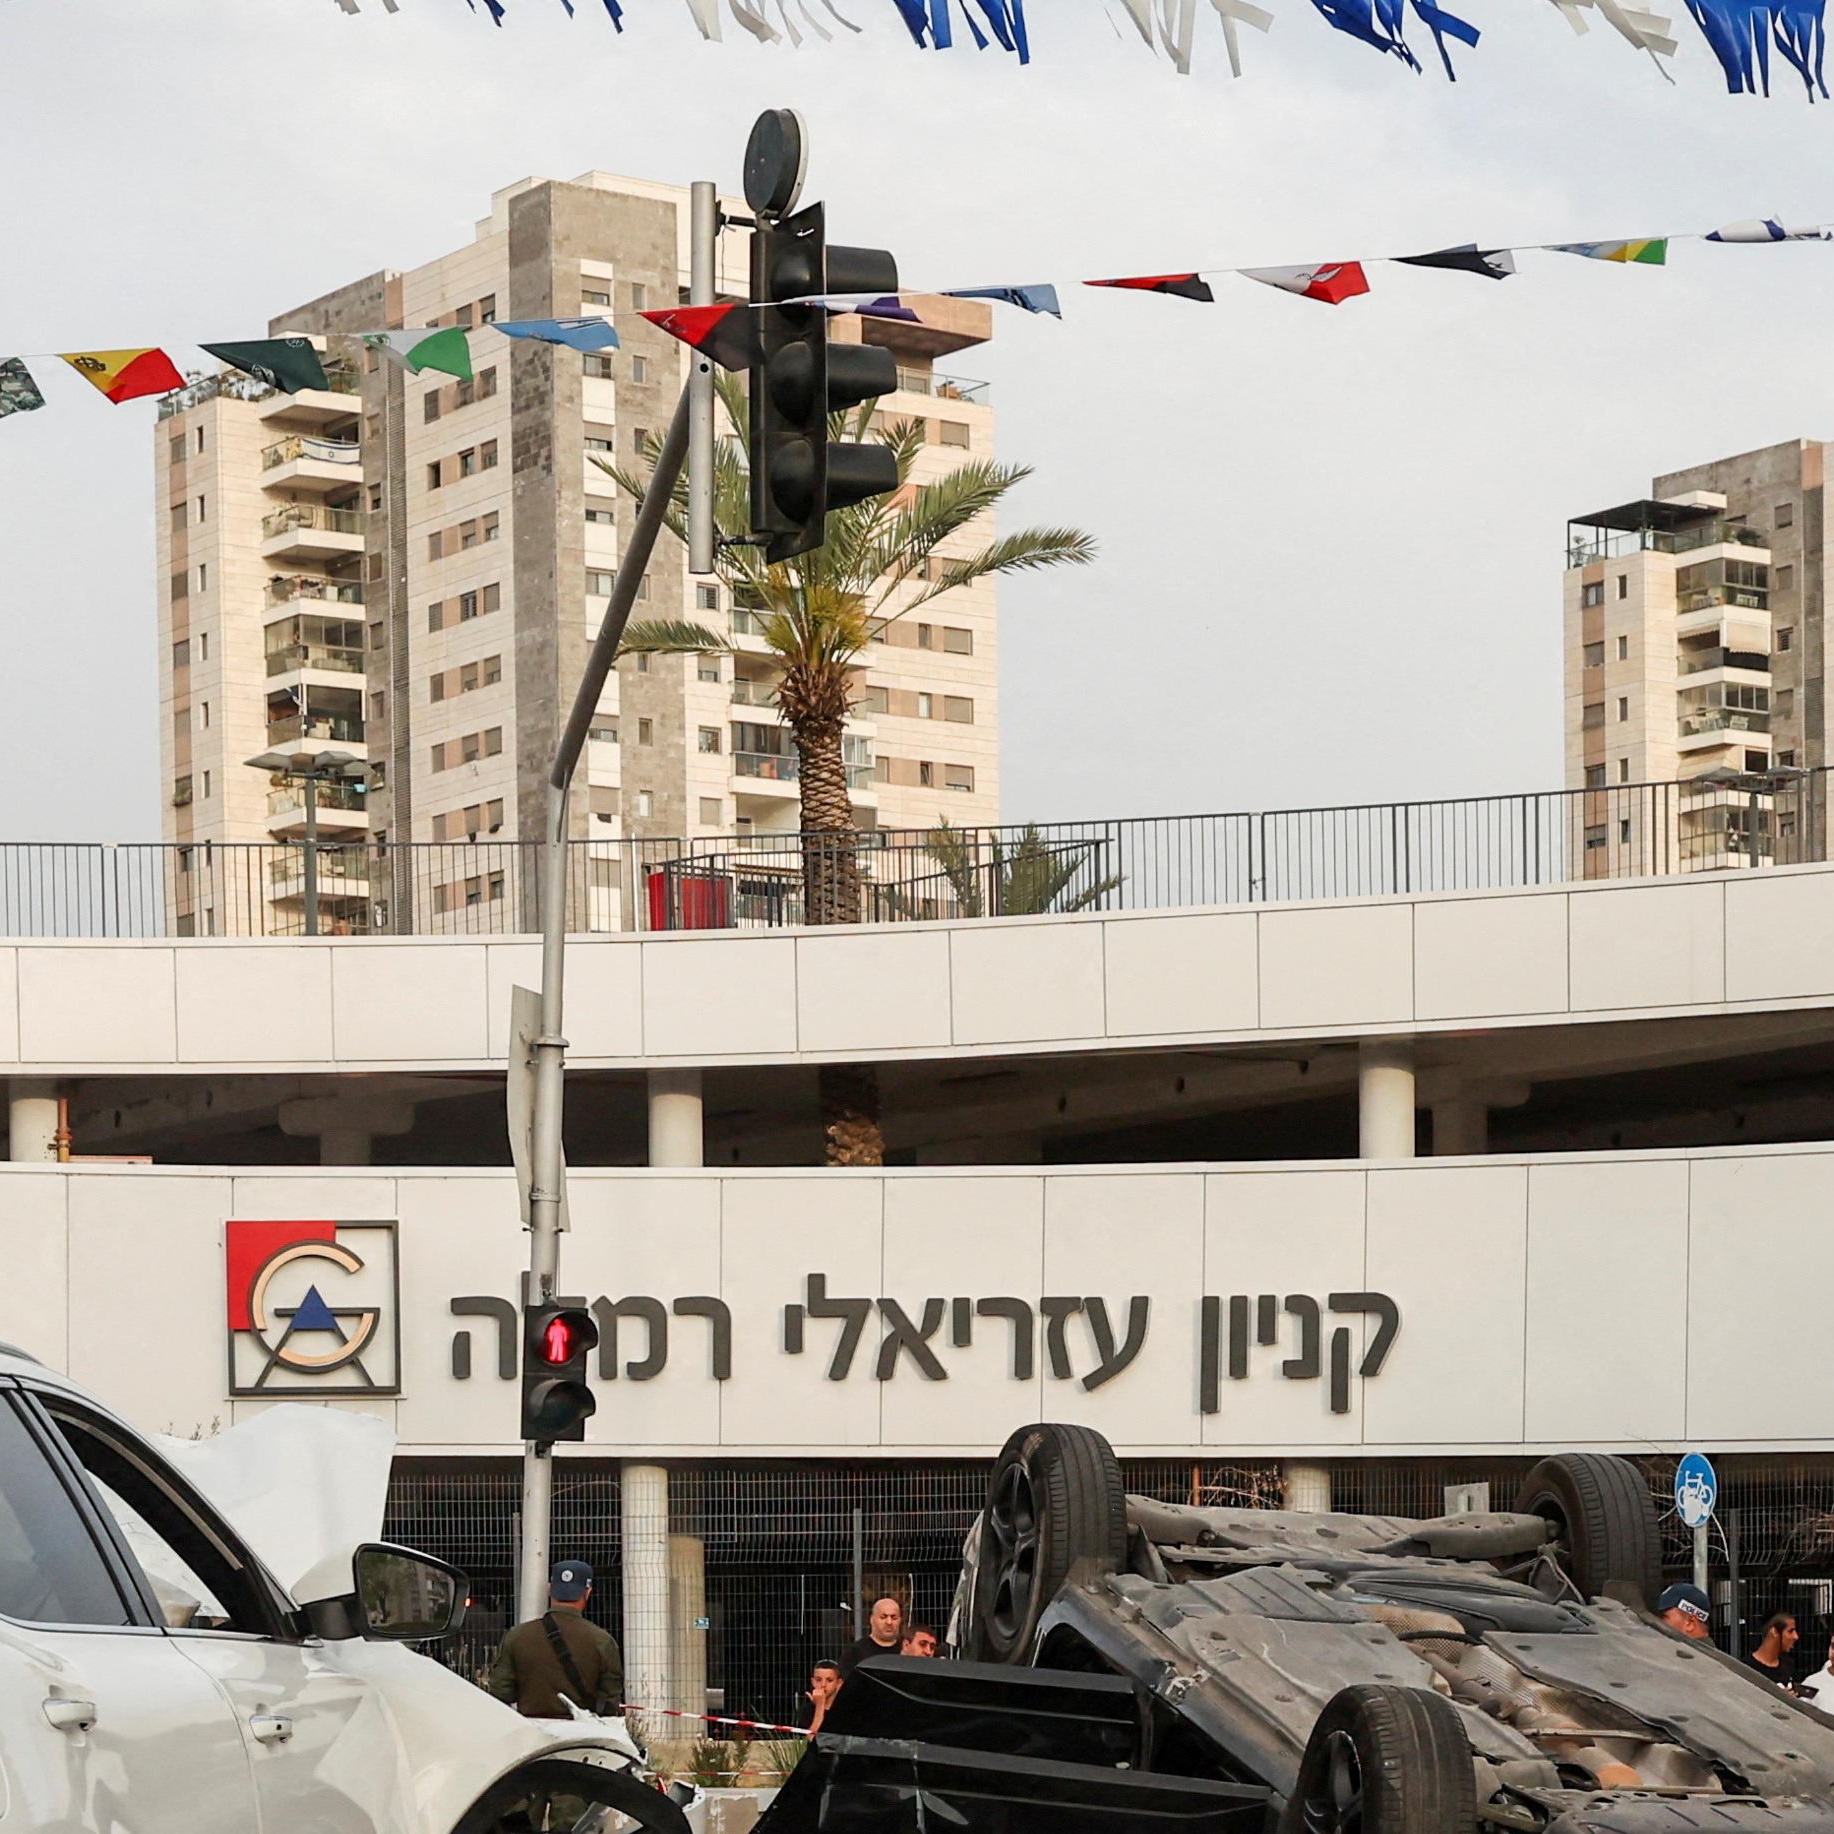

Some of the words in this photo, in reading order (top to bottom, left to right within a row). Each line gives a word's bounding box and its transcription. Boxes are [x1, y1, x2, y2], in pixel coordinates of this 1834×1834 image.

[450, 1270, 732, 1381] רמה
[784, 1273, 1151, 1392] עזריאלי
[1201, 1292, 1401, 1415] קניון
